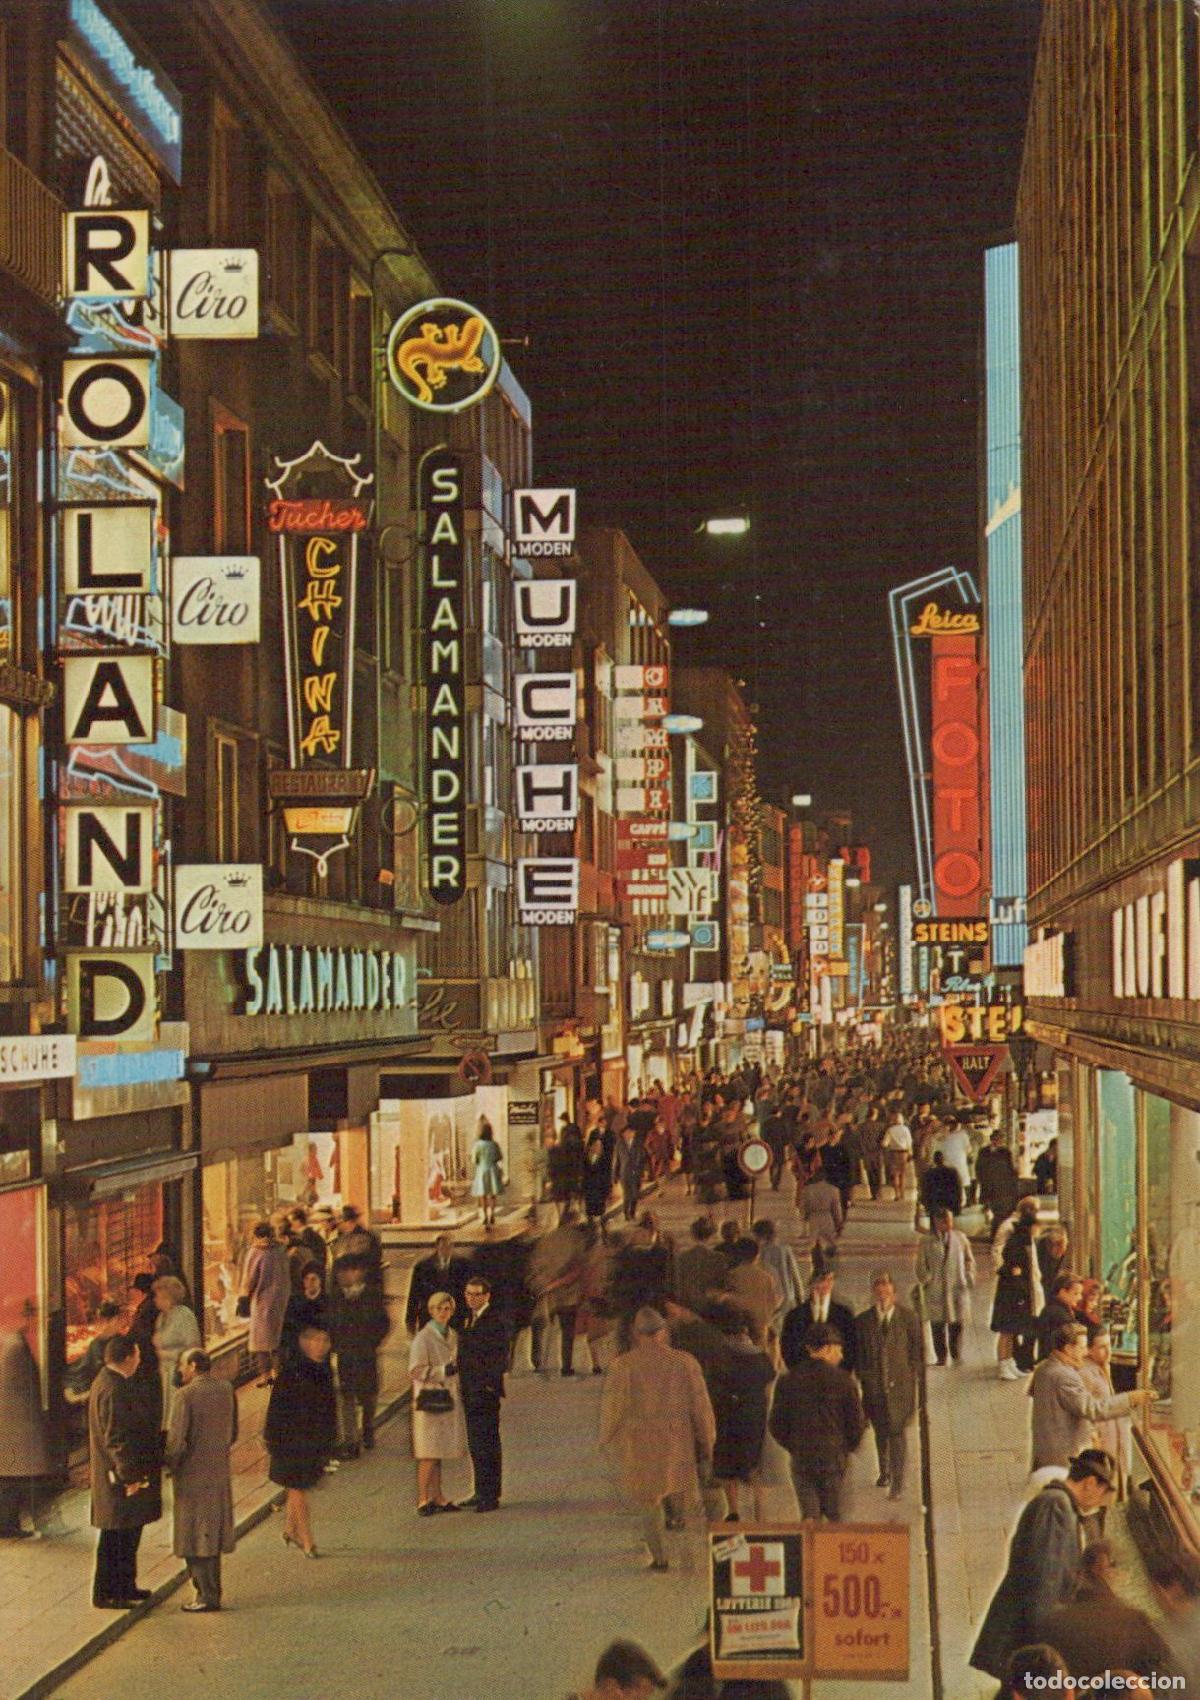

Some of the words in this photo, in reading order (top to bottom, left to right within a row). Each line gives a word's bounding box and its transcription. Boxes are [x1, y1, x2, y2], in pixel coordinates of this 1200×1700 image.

[176, 270, 249, 320] Ciro
[268, 500, 366, 530] Tucher
[519, 541, 572, 555] MODEN
[177, 578, 250, 628] Ciro
[910, 602, 981, 635] Leica
[68, 214, 147, 1036] ROLAND
[519, 634, 572, 647] MODEN
[298, 537, 343, 757] CHINA
[431, 468, 462, 888] SALAMANDER
[519, 495, 573, 906] MUCHE
[521, 726, 573, 740] MODEN
[932, 657, 981, 896] FOTO
[522, 818, 574, 832] MODEN
[180, 885, 253, 936] Ciro
[522, 910, 574, 925] MODEN
[915, 922, 988, 942] STEINS
[246, 944, 406, 1015] SALAMANDER
[0, 1042, 58, 1074] SCHUHE
[962, 1056, 990, 1070] HALT
[839, 1542, 870, 1564] 150
[834, 1628, 892, 1647] sofort
